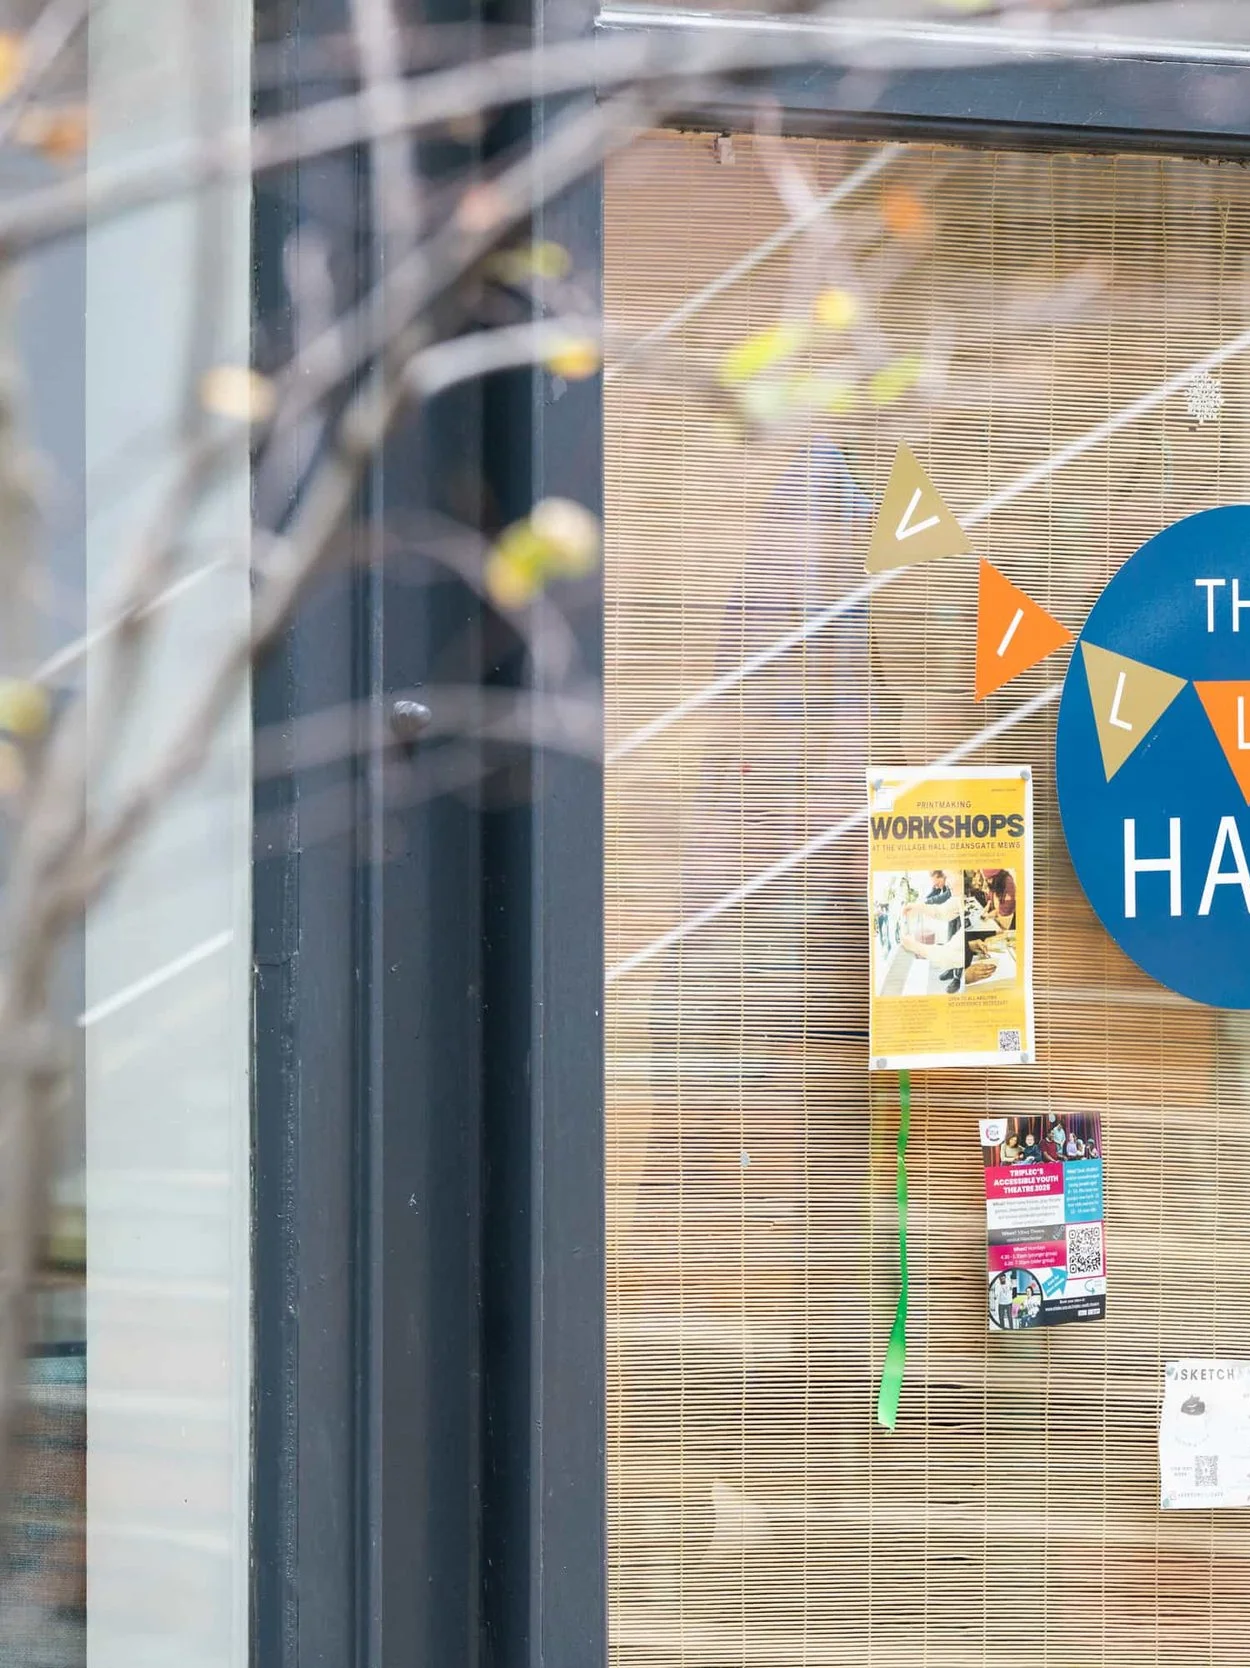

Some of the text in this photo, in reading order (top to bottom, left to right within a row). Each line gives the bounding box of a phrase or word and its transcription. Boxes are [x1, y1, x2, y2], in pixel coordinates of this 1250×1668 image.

[917, 800, 971, 809] PRINTMAKING
[870, 813, 1025, 840] WORKSHOPS
[950, 842, 994, 850] DEANSGATE
[994, 1178, 1035, 1186] ACCESSIBLE
[1004, 1185, 1034, 1194] THEATRE
